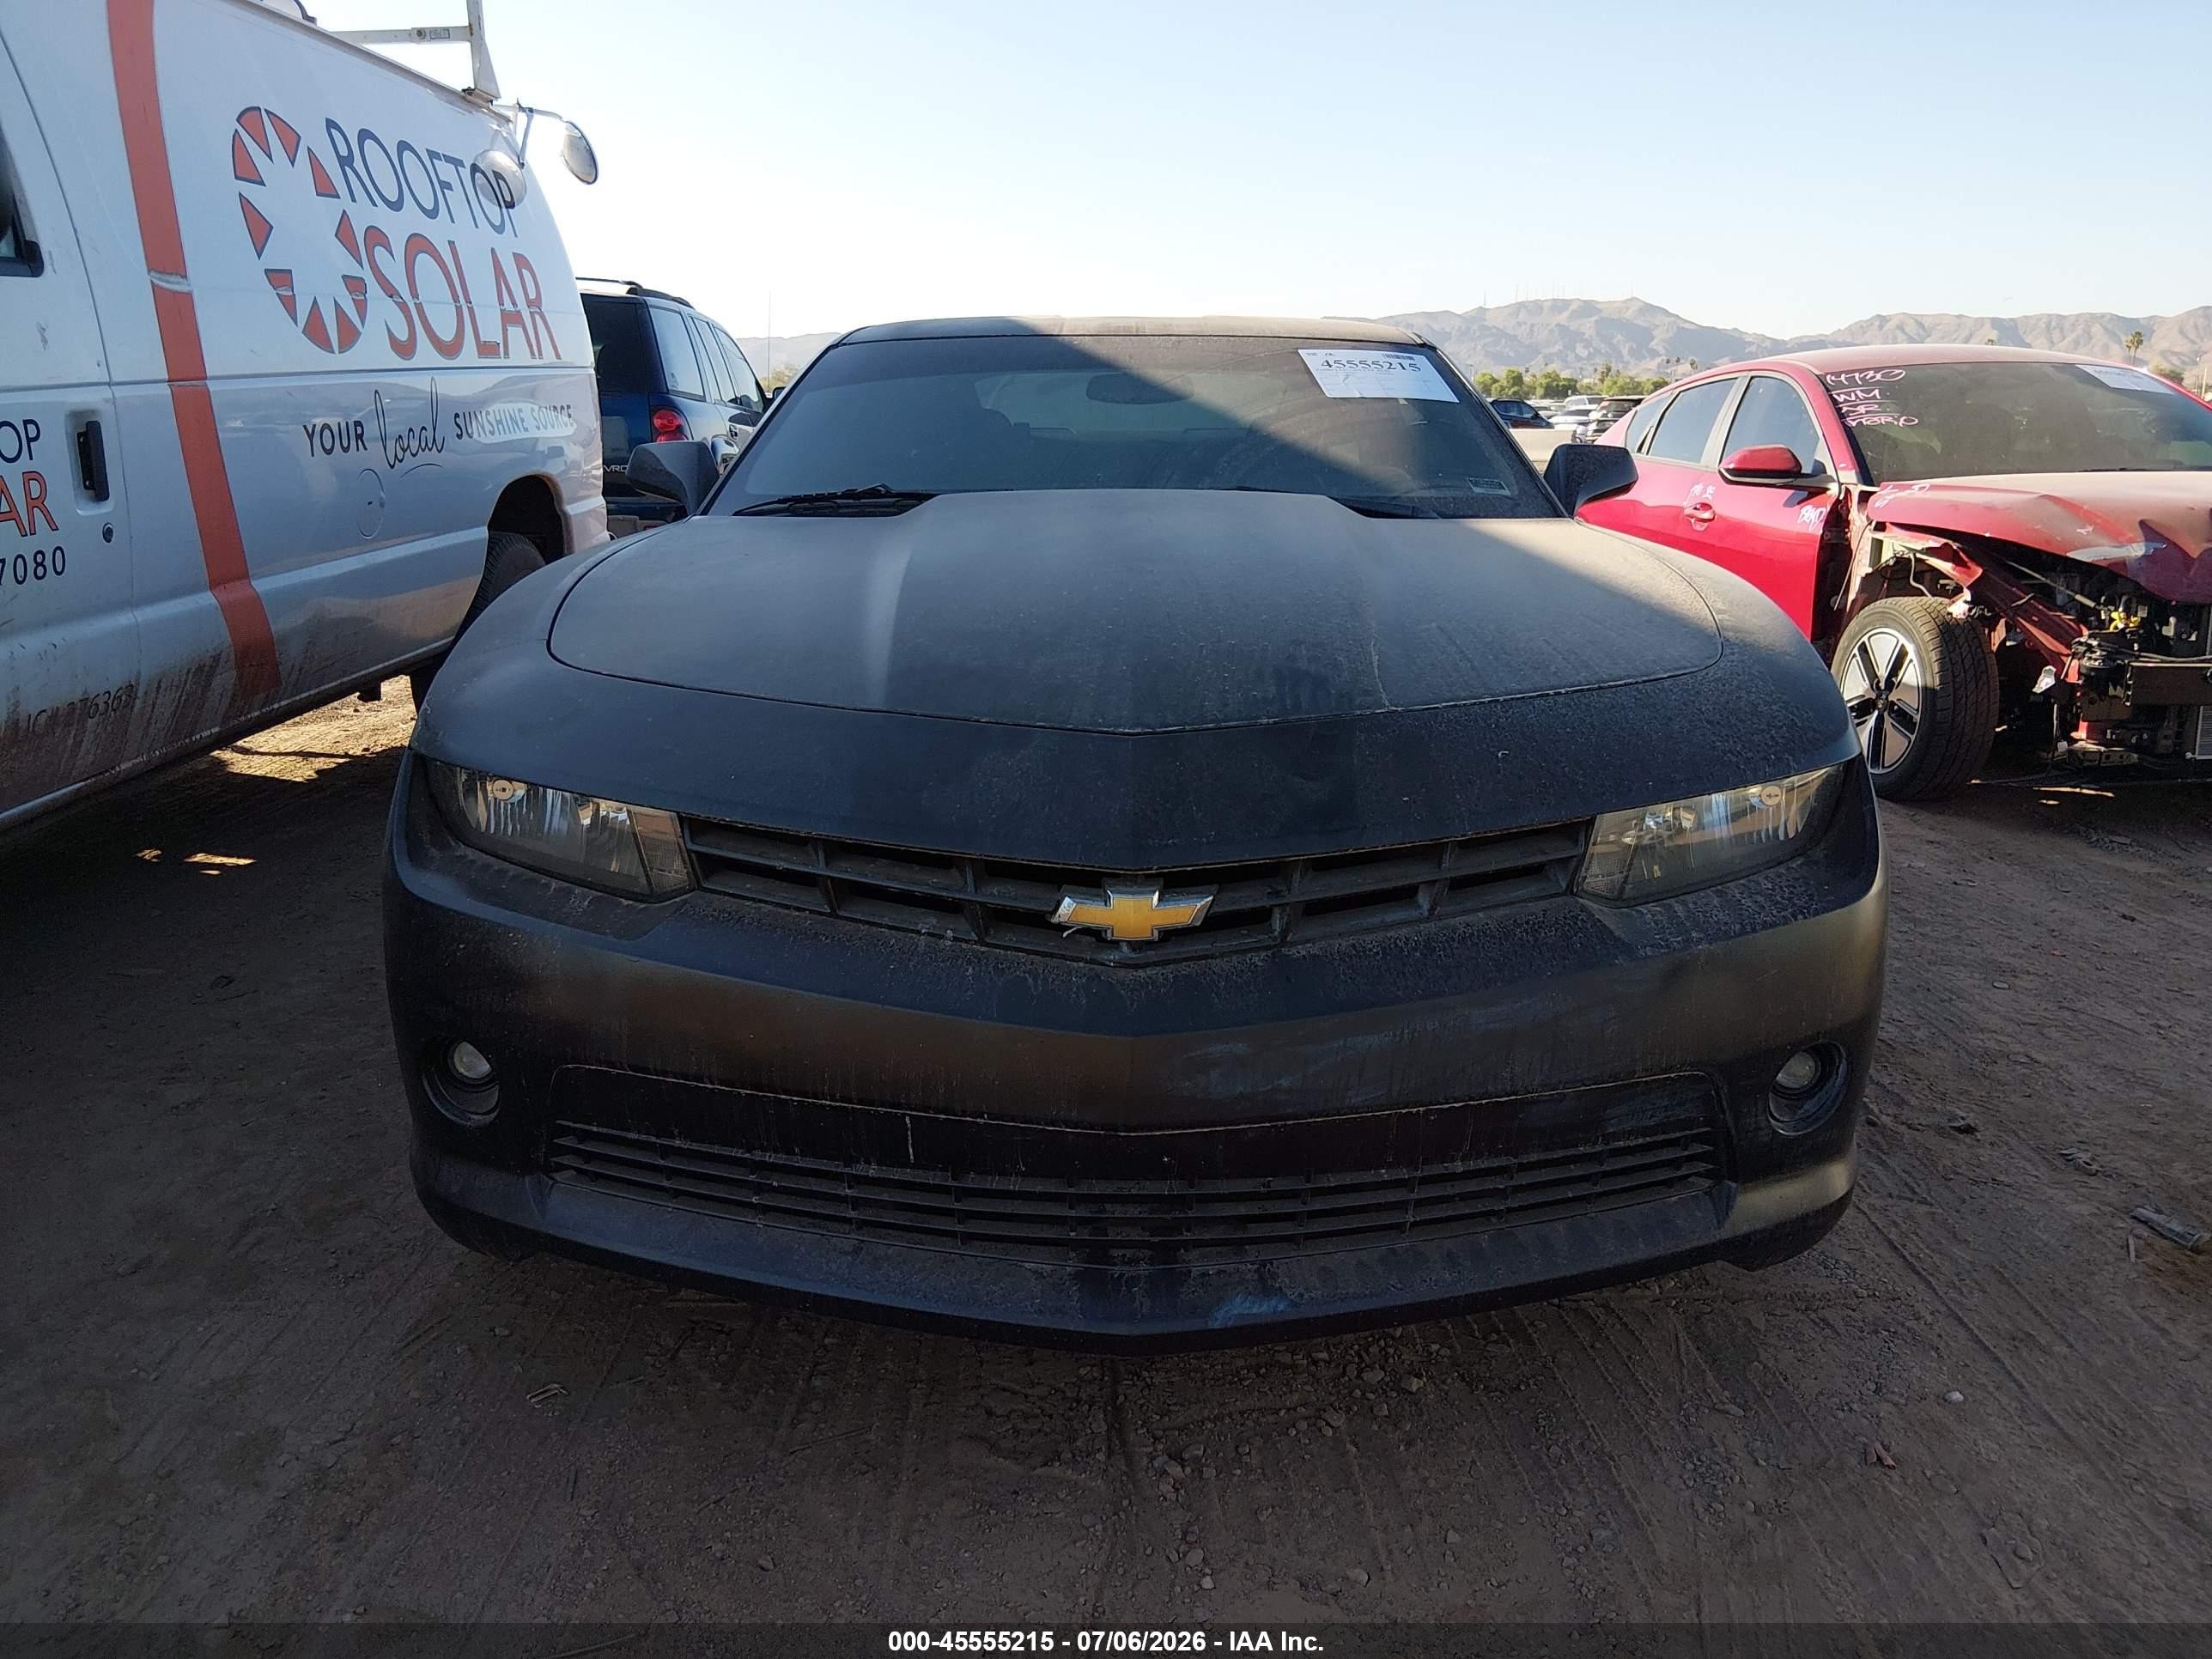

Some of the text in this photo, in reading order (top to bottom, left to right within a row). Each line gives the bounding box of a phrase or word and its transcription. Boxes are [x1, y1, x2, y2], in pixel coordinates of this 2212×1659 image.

[325, 117, 518, 239] ROOFTOP
[363, 225, 562, 361] SOLAR
[1321, 359, 1422, 372] 45555215
[303, 376, 574, 469] YOUR local SUNSHINE SOURCE
